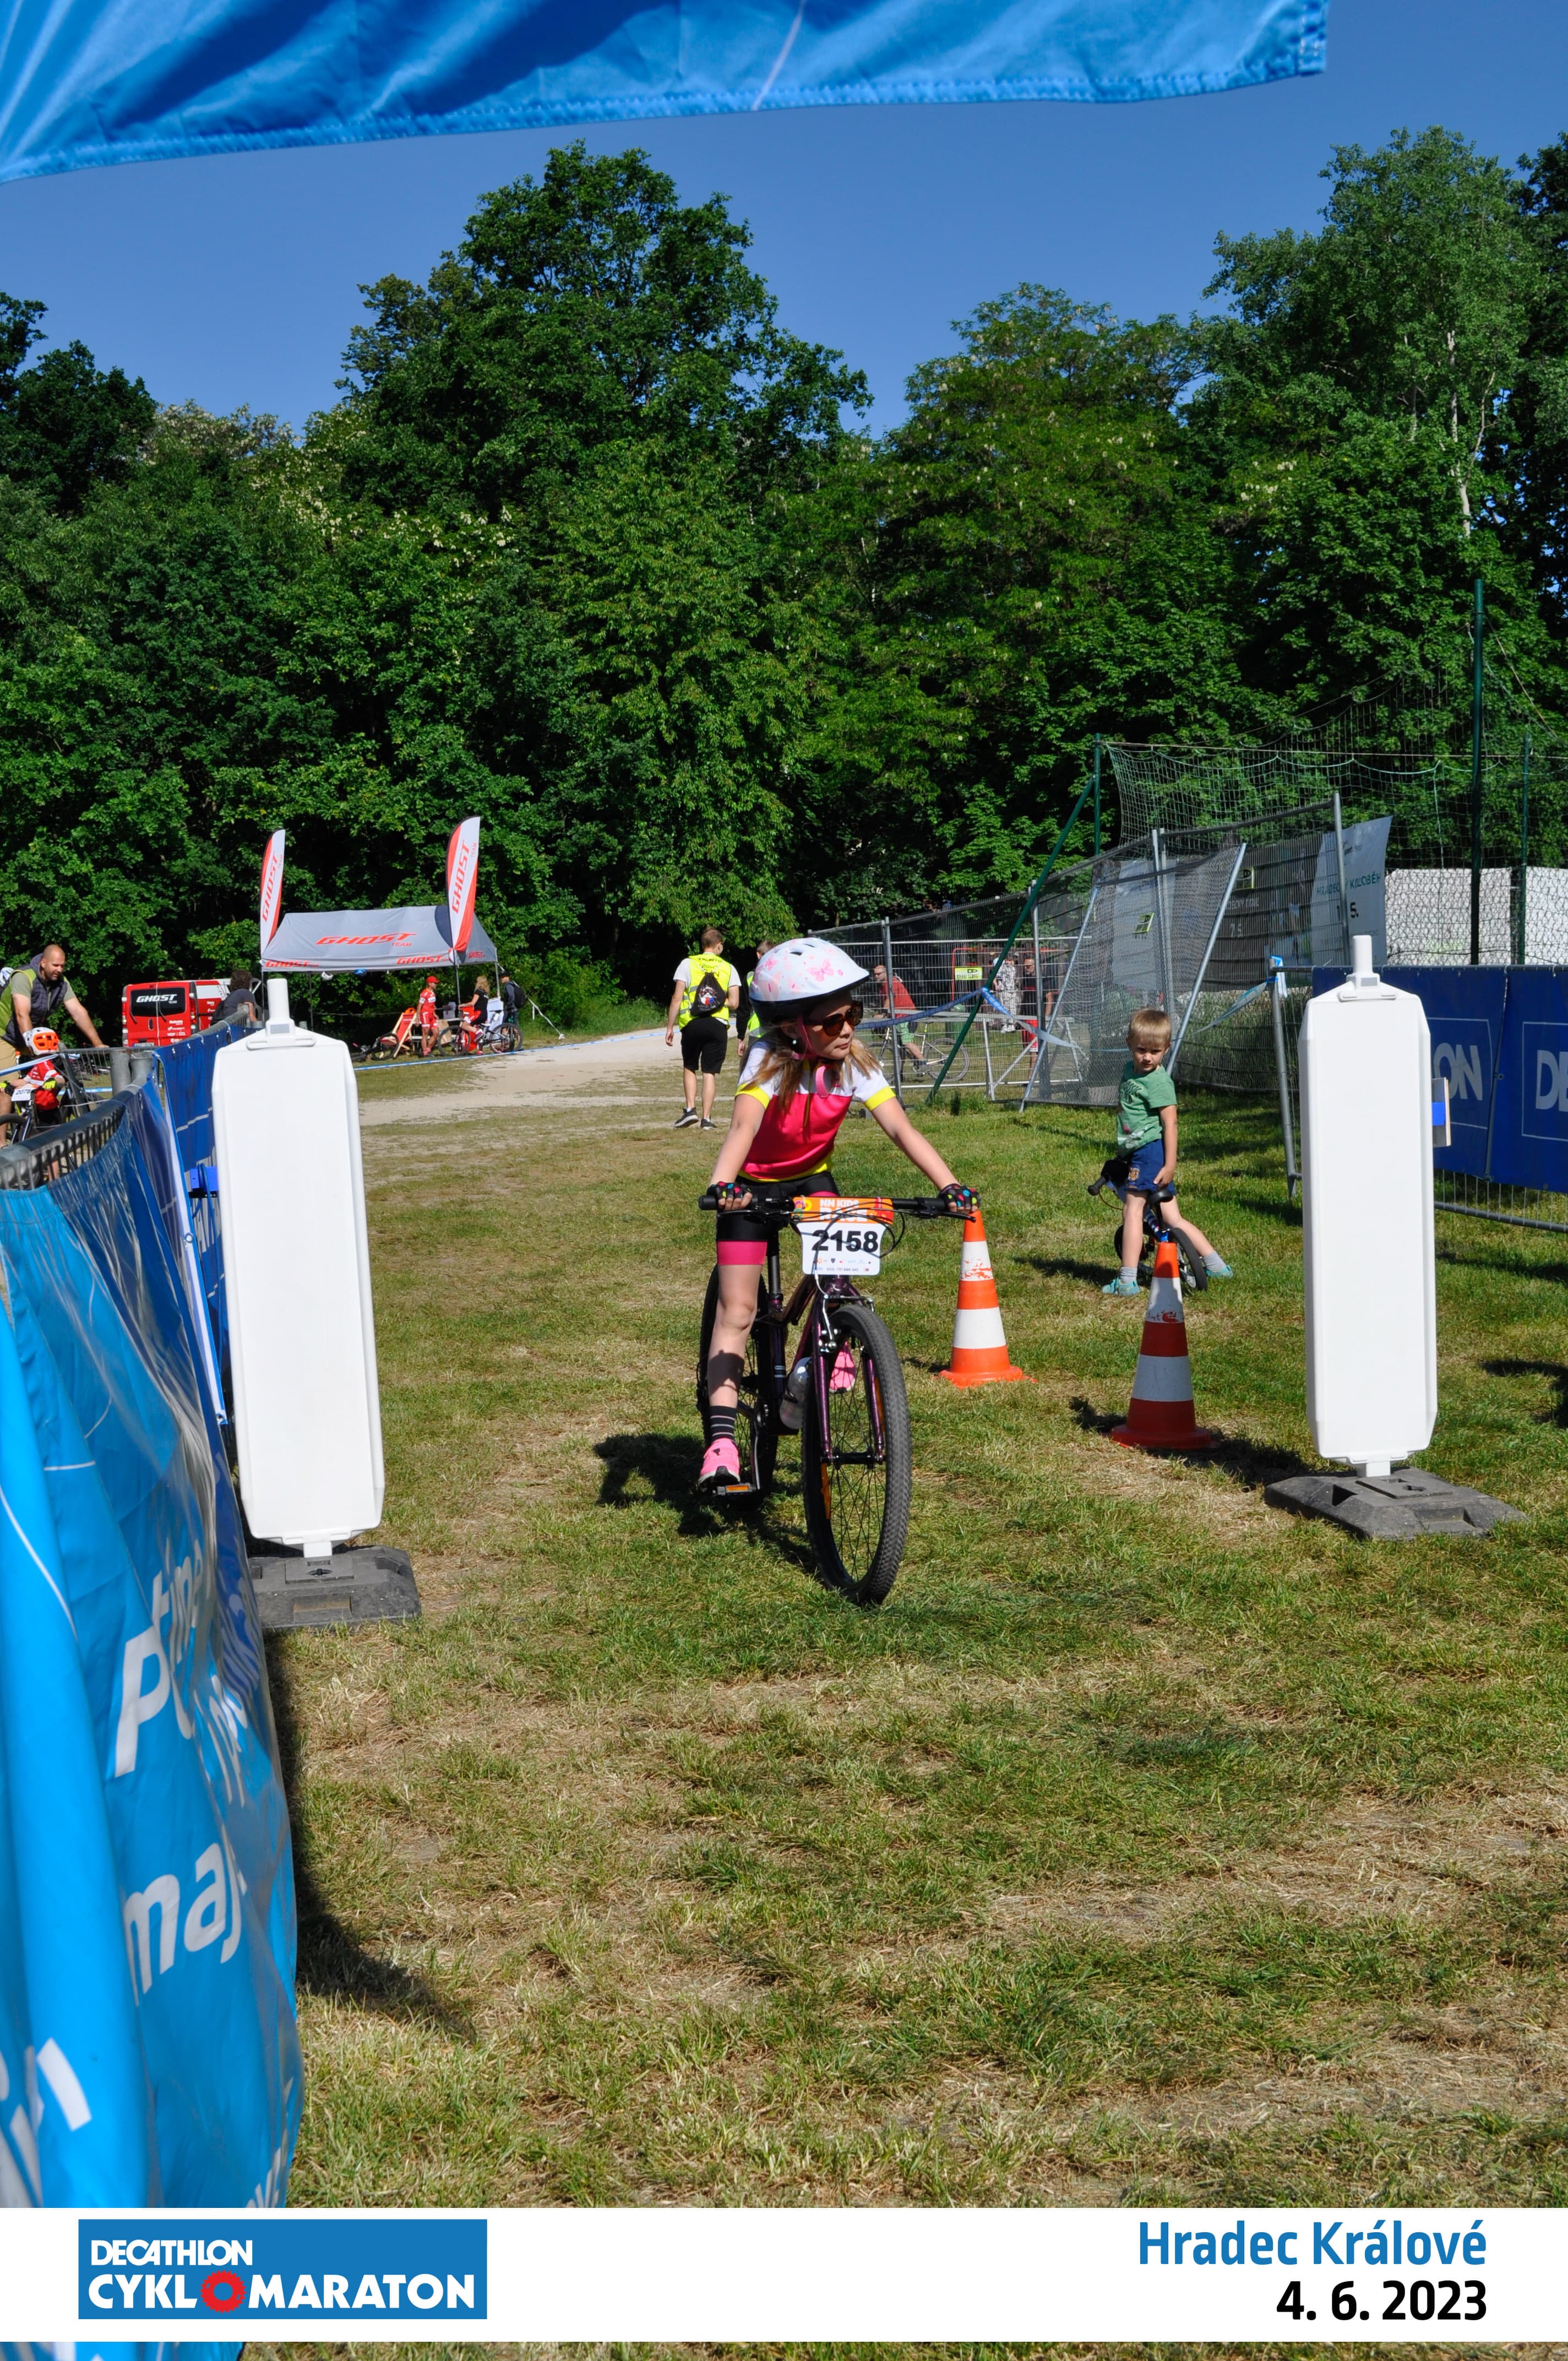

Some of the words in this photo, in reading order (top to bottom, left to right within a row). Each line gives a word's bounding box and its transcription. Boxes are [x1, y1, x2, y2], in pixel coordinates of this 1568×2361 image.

[451, 840, 470, 914] GHOST
[262, 850, 279, 923] GHOST
[316, 932, 417, 945] GHOST
[265, 959, 310, 967] GHOST
[396, 954, 443, 965] GHOST
[136, 993, 177, 1003] GHOST
[819, 1199, 835, 1207] NN
[836, 1199, 859, 1208] KIDS
[811, 1229, 879, 1253] 2158
